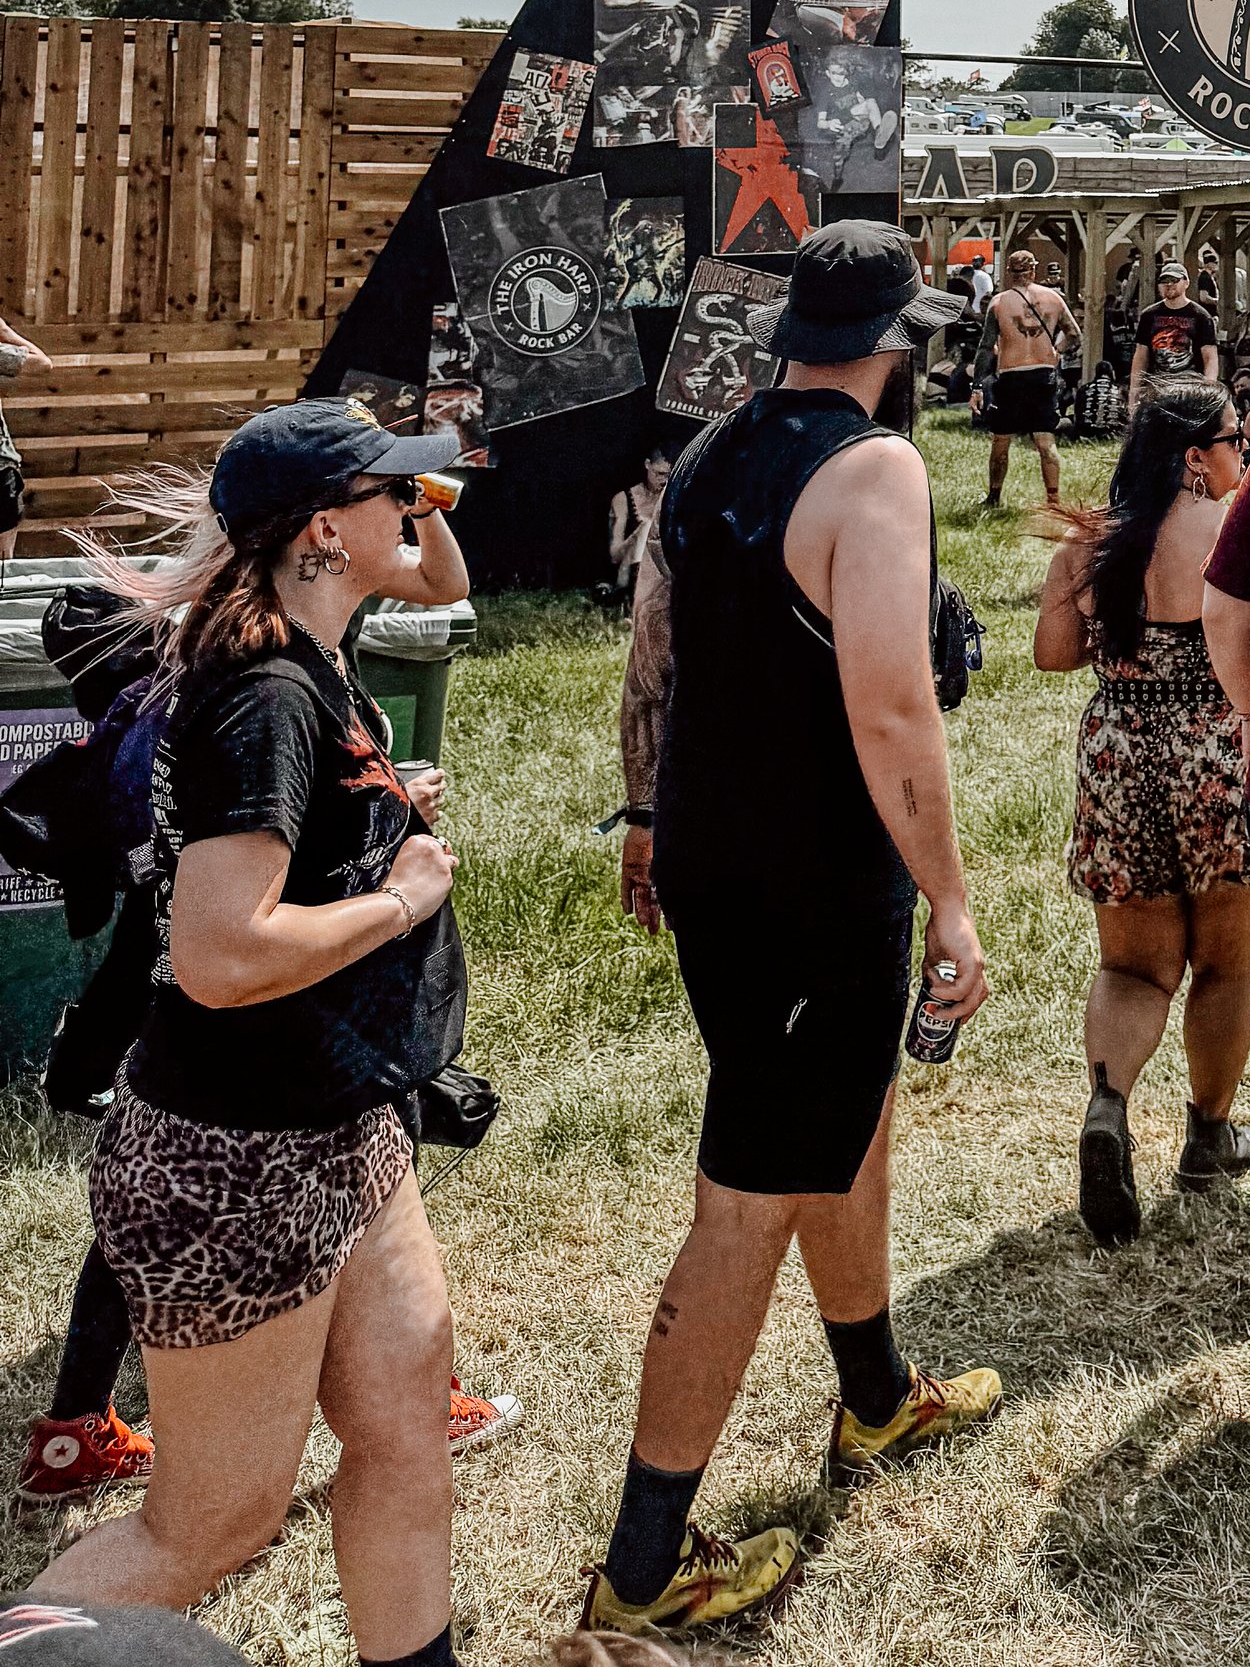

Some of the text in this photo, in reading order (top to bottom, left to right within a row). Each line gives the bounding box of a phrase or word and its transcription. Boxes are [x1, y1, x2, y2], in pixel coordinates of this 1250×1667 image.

[494, 253, 592, 316] THE IRON HARP
[517, 322, 584, 349] ROCK BAR
[0, 721, 94, 743] OMPOSTABL
[10, 886, 56, 902] RECYCLE
[919, 1012, 954, 1029] PEPSI
